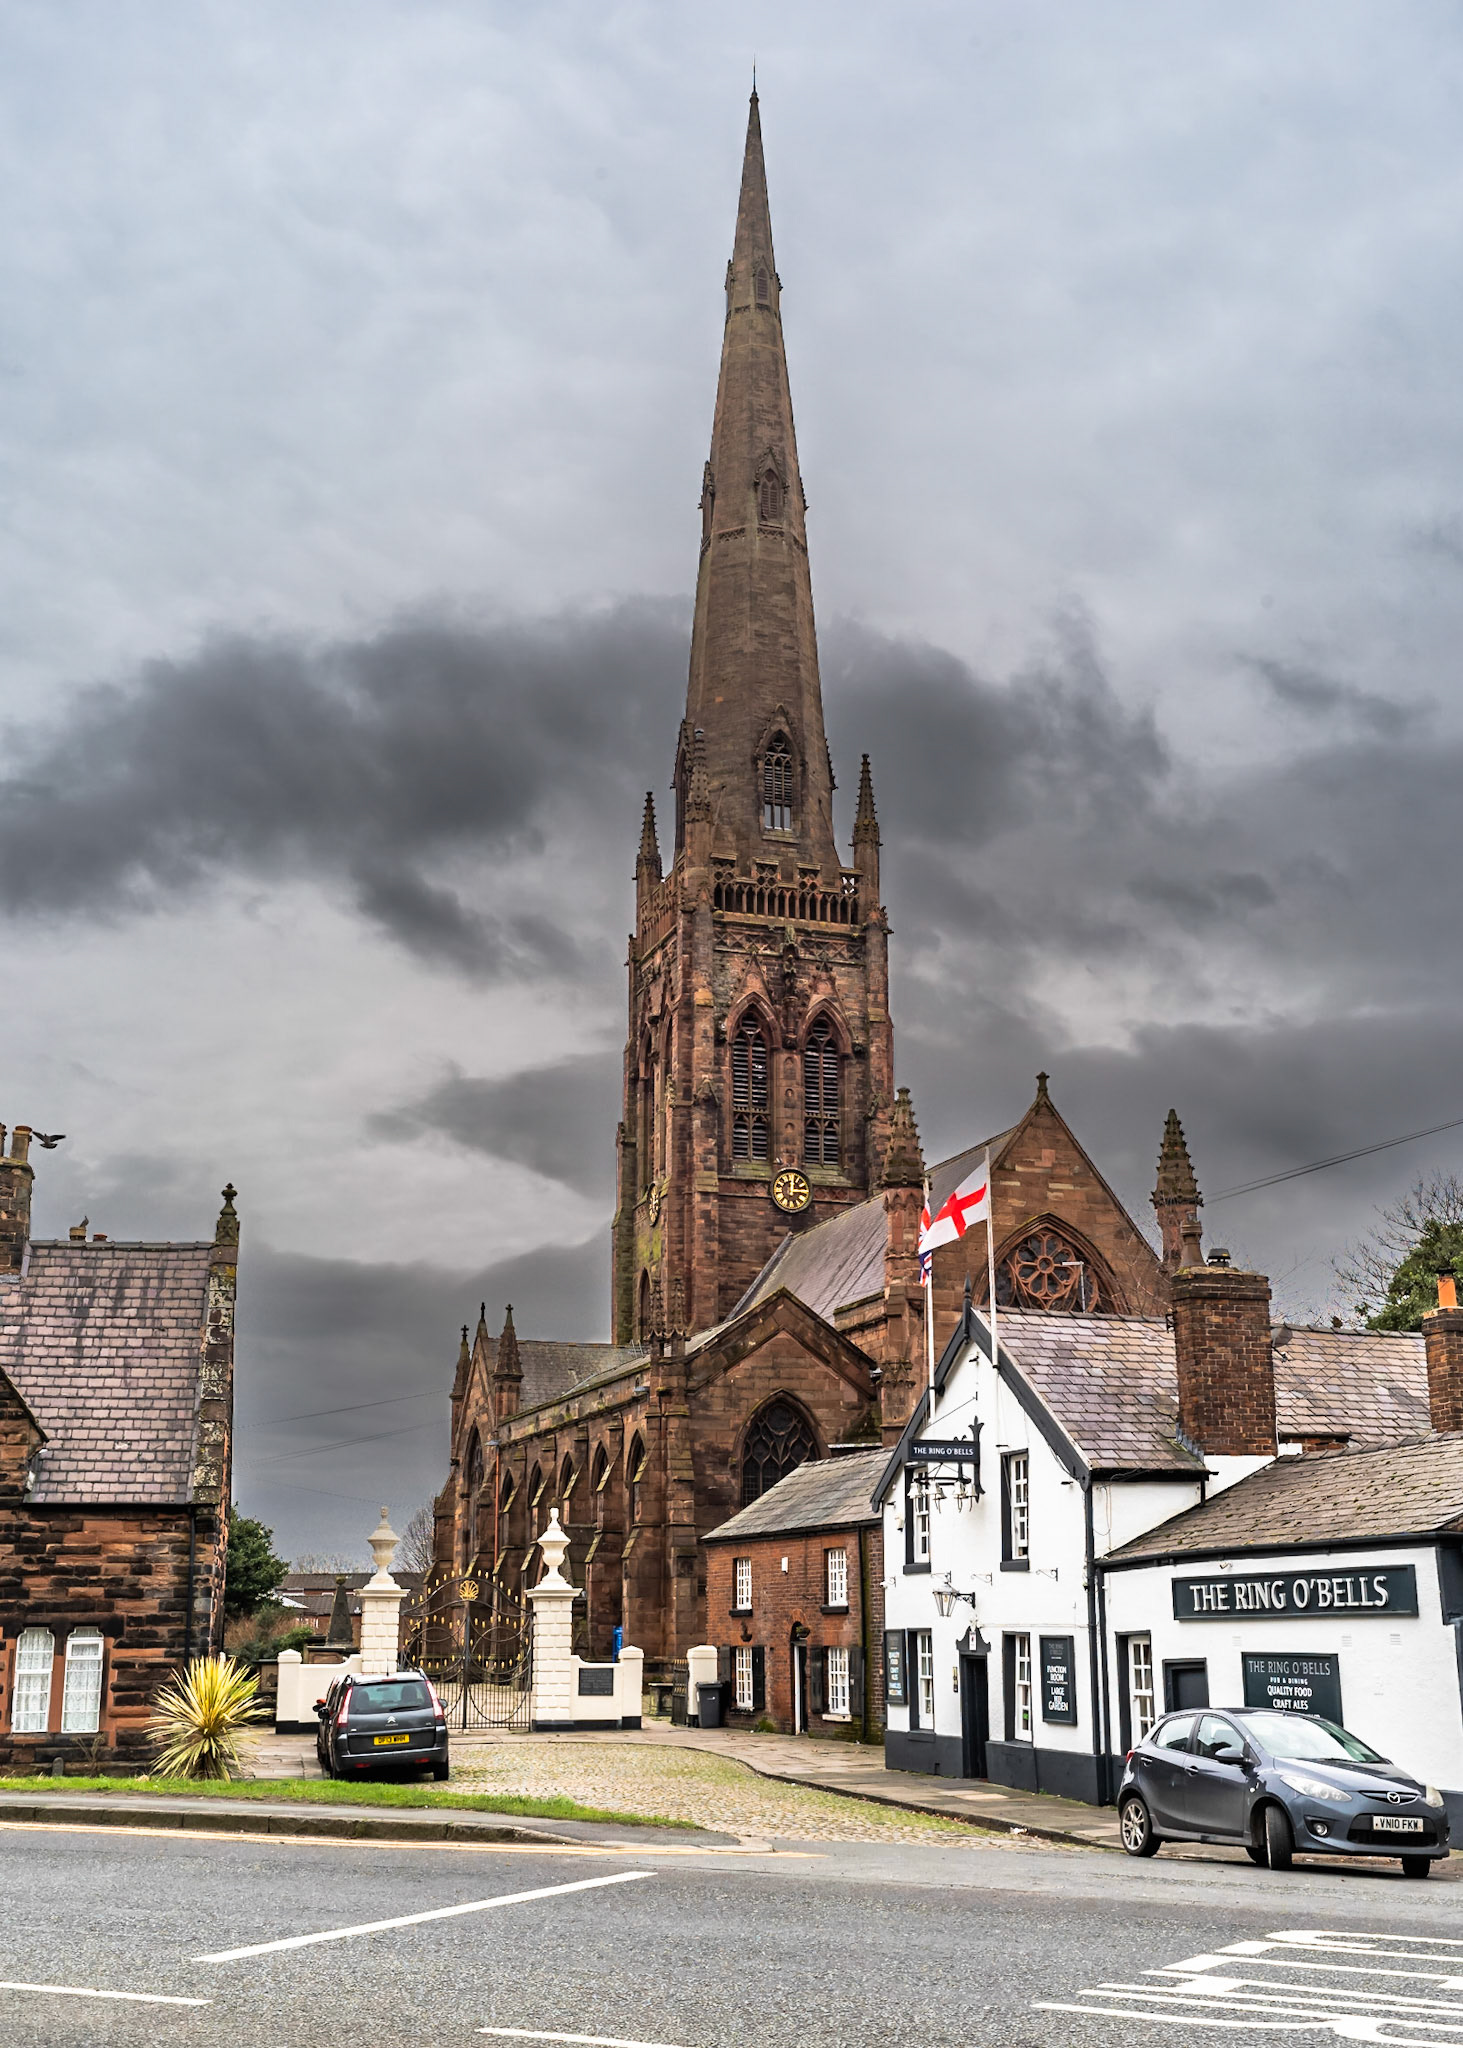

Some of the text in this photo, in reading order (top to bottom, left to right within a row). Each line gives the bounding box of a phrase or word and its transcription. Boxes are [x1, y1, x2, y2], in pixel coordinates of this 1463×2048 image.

[928, 1447, 945, 1455] RING
[946, 1448, 974, 1456] O'BELLS
[1189, 1576, 1389, 1611] THE RING O'BELLS
[1248, 1660, 1331, 1675] THE RING O'BELLS
[1267, 1685, 1313, 1697] QUALITY FOOD
[1272, 1699, 1309, 1710] CRAFT ALES
